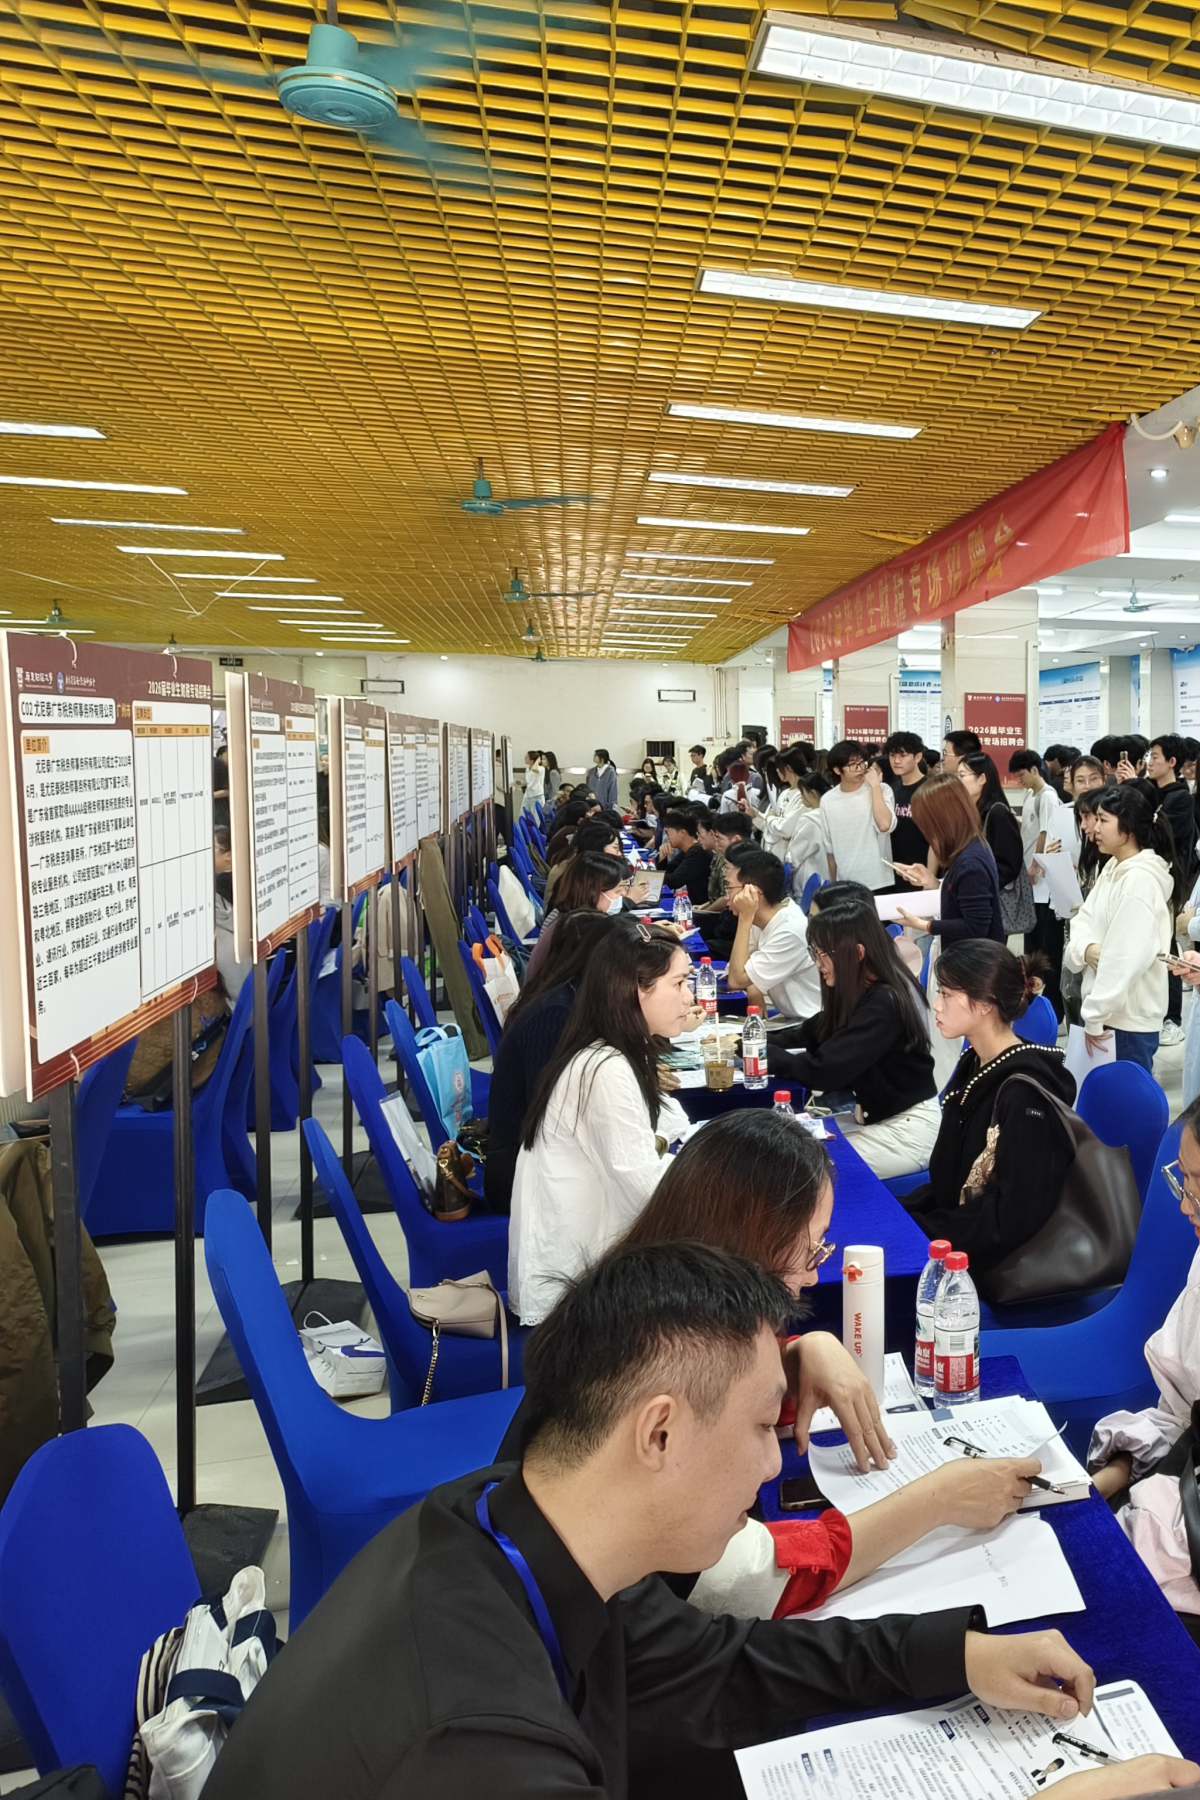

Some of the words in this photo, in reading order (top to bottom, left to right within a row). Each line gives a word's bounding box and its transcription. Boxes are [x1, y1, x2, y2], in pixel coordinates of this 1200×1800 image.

[34, 702, 114, 719] 尤尼泰广东税务师事务所有限公司
[968, 726, 1023, 735] 2026届毕业生
[978, 737, 1024, 746] 专场招聘会
[854, 1312, 862, 1339] WAKE
